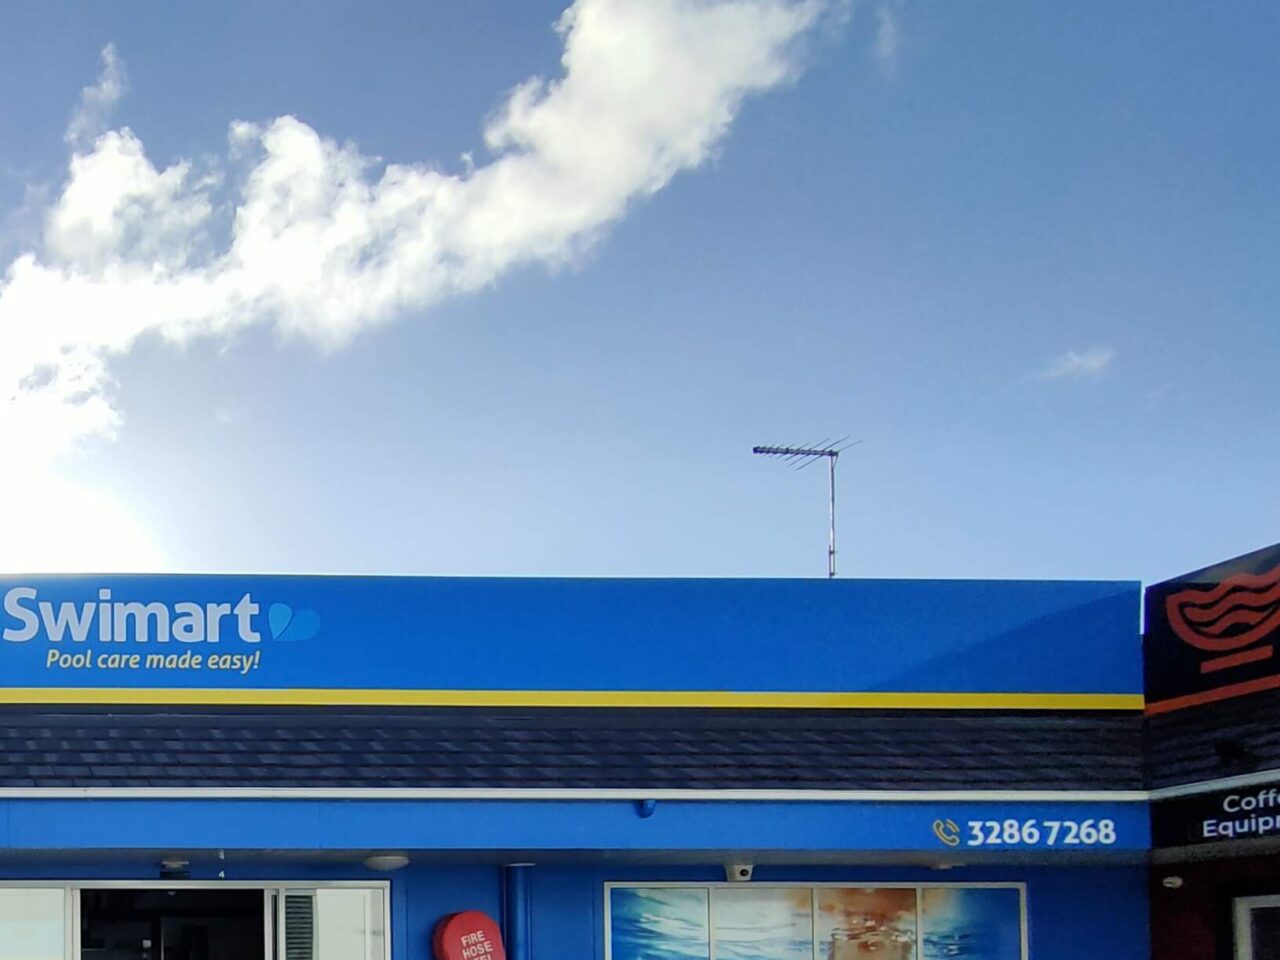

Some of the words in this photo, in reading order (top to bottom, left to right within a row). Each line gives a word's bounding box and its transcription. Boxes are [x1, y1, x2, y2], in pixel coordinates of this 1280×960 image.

[2, 586, 262, 643] Swimart
[45, 649, 93, 669] Pool
[96, 654, 141, 669] care
[145, 650, 201, 669] made
[206, 650, 261, 675] easy!
[460, 930, 486, 948] FIRE
[462, 941, 493, 960] HOSE
